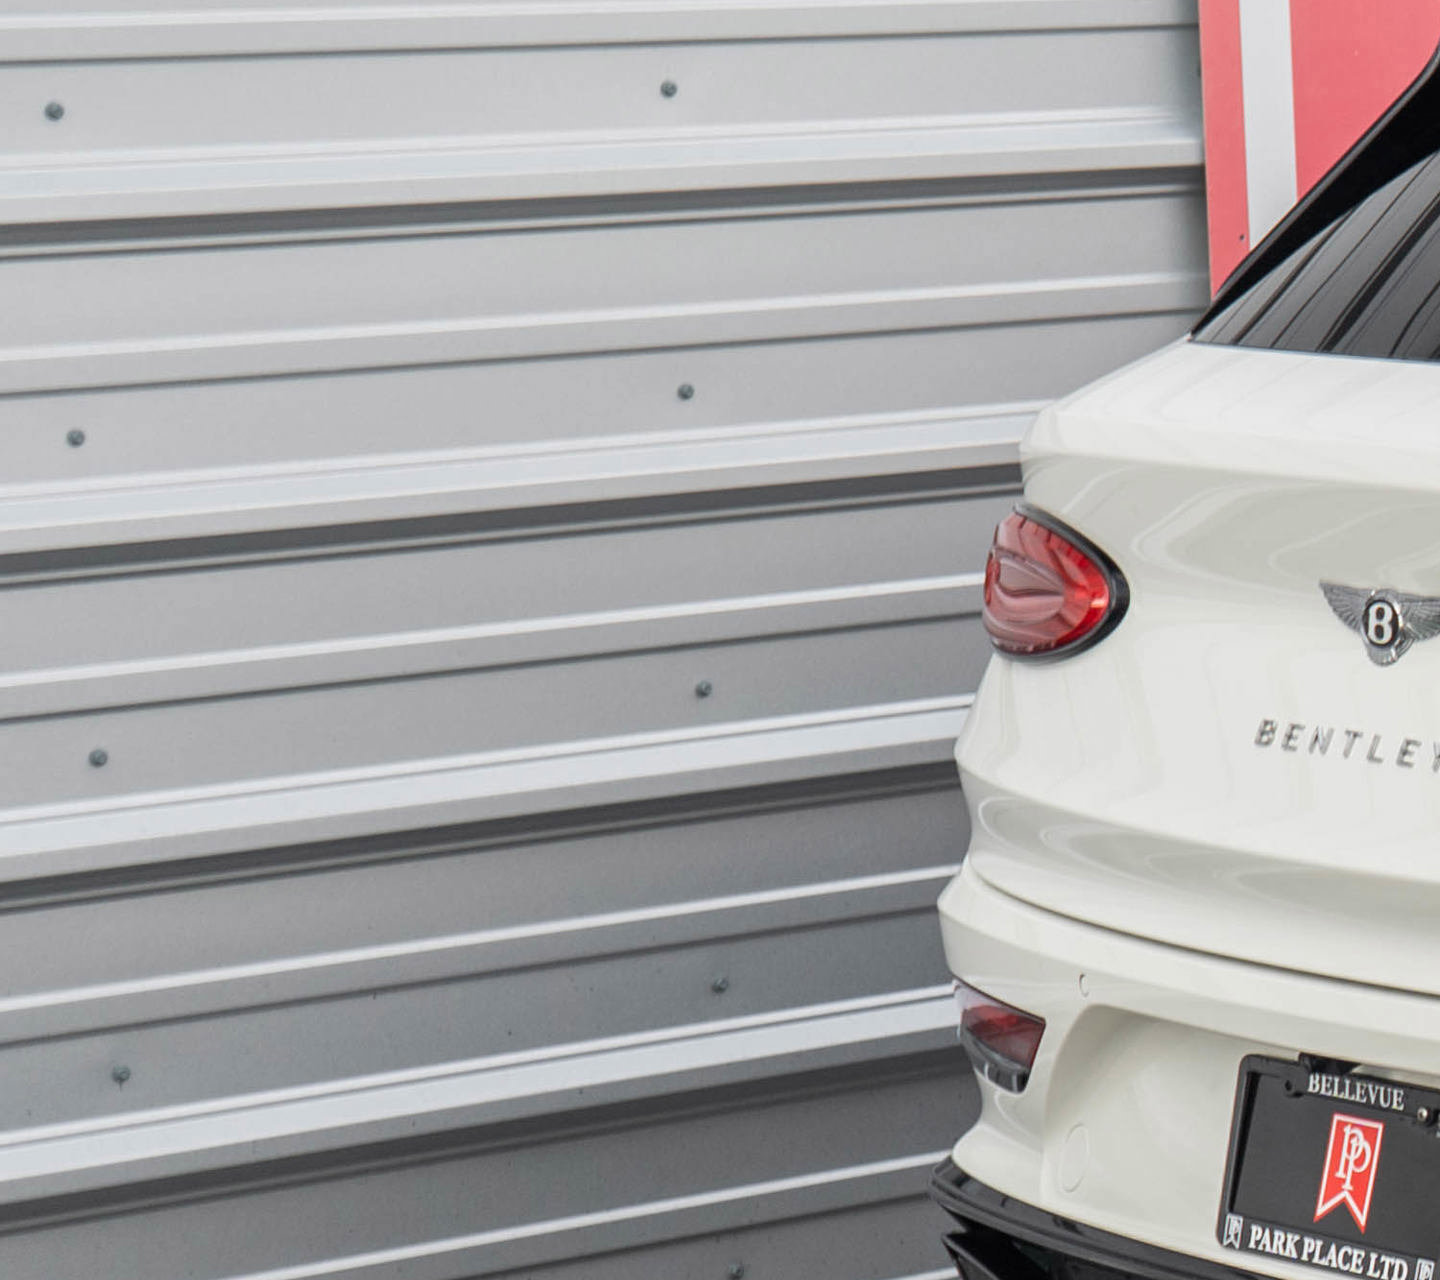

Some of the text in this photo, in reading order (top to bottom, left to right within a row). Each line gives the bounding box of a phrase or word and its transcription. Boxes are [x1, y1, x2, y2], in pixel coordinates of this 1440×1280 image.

[1366, 601, 1395, 645] B
[1307, 1072, 1405, 1112] BELLEVUE
[1248, 1223, 1302, 1259] PARK
[1301, 1236, 1366, 1275] PLACE
